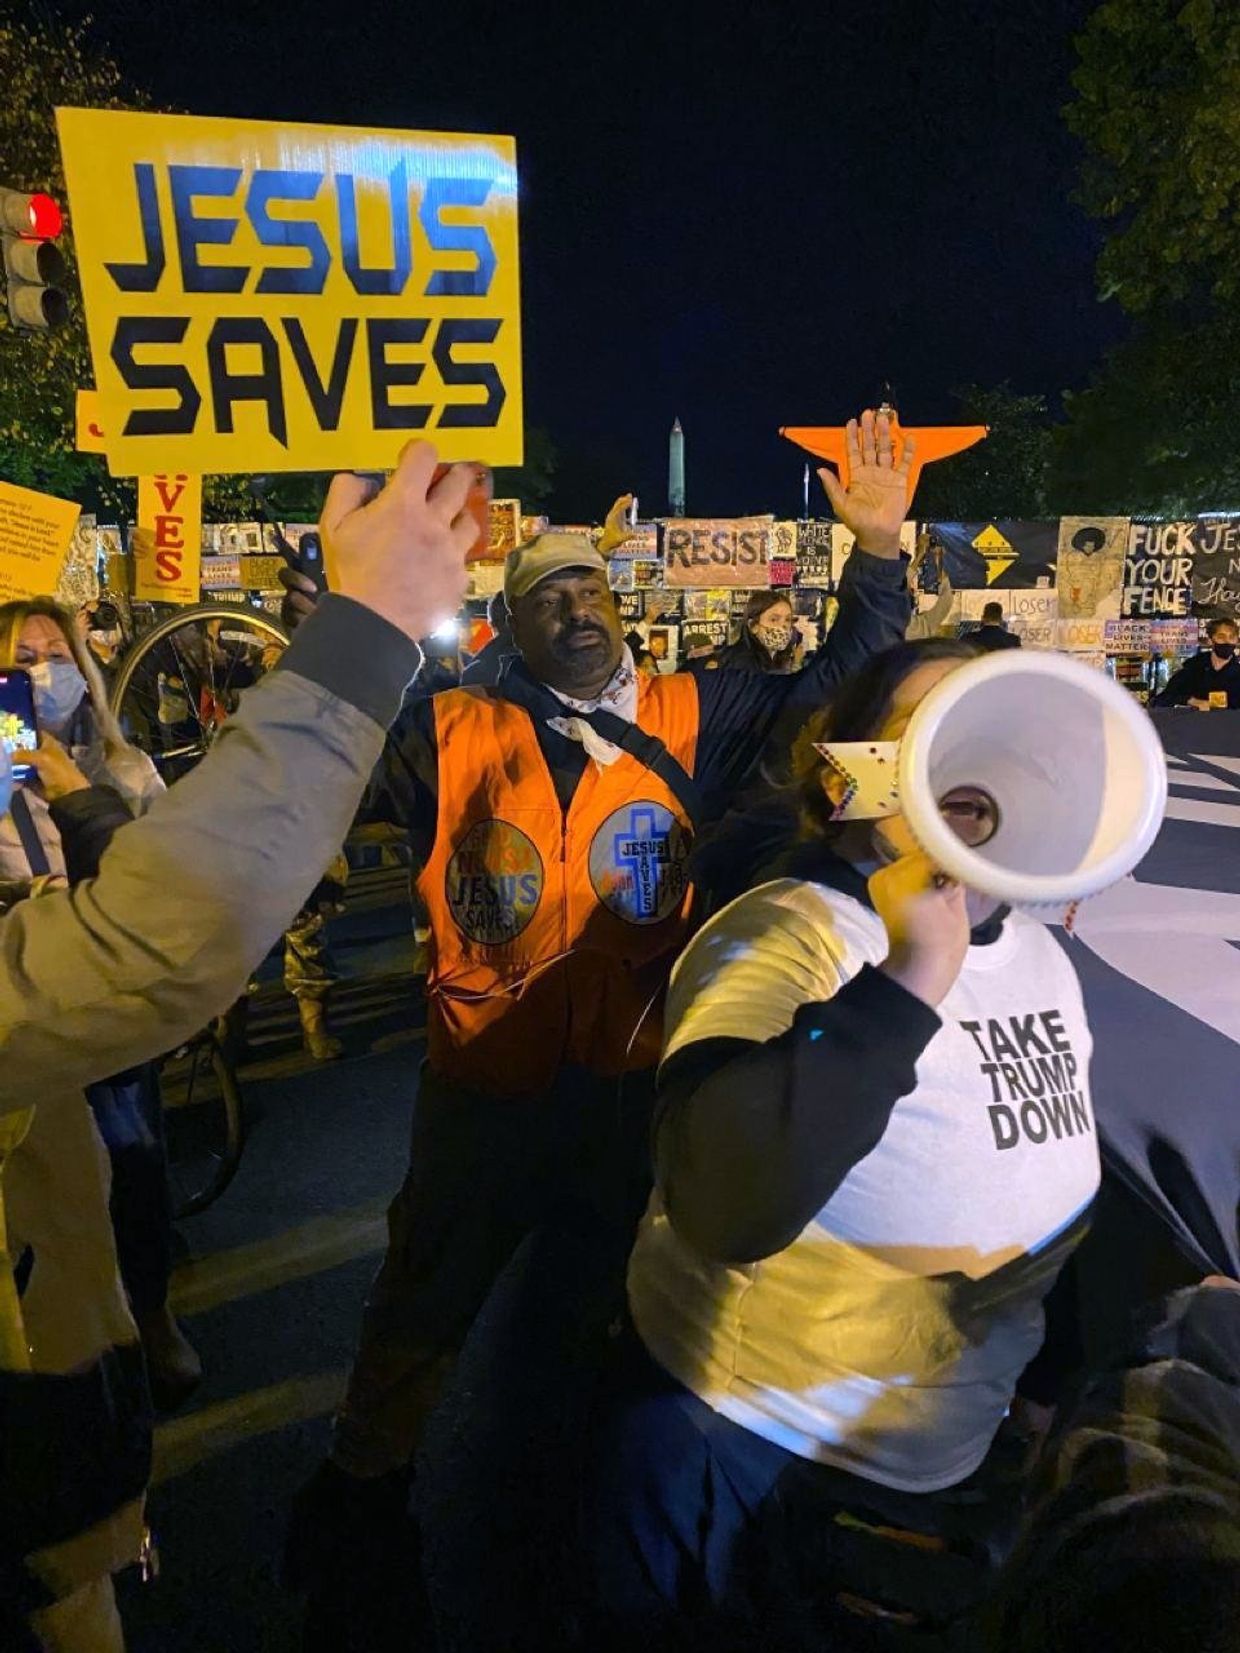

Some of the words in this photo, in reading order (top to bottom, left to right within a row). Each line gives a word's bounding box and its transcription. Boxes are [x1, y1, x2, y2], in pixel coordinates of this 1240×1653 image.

[103, 157, 500, 297] JESUS
[110, 316, 507, 449] SAVES
[153, 474, 188, 582] VES
[667, 529, 769, 568] RESIST
[1128, 522, 1196, 555] FUCK
[1125, 558, 1194, 587] YOUR
[1123, 586, 1187, 616] FENCE
[622, 840, 664, 857] JESUS
[453, 873, 538, 906] JESUS
[959, 1009, 1071, 1062] TAKE
[980, 1052, 1077, 1102] TRUMP
[986, 1090, 1091, 1150] DOWN
